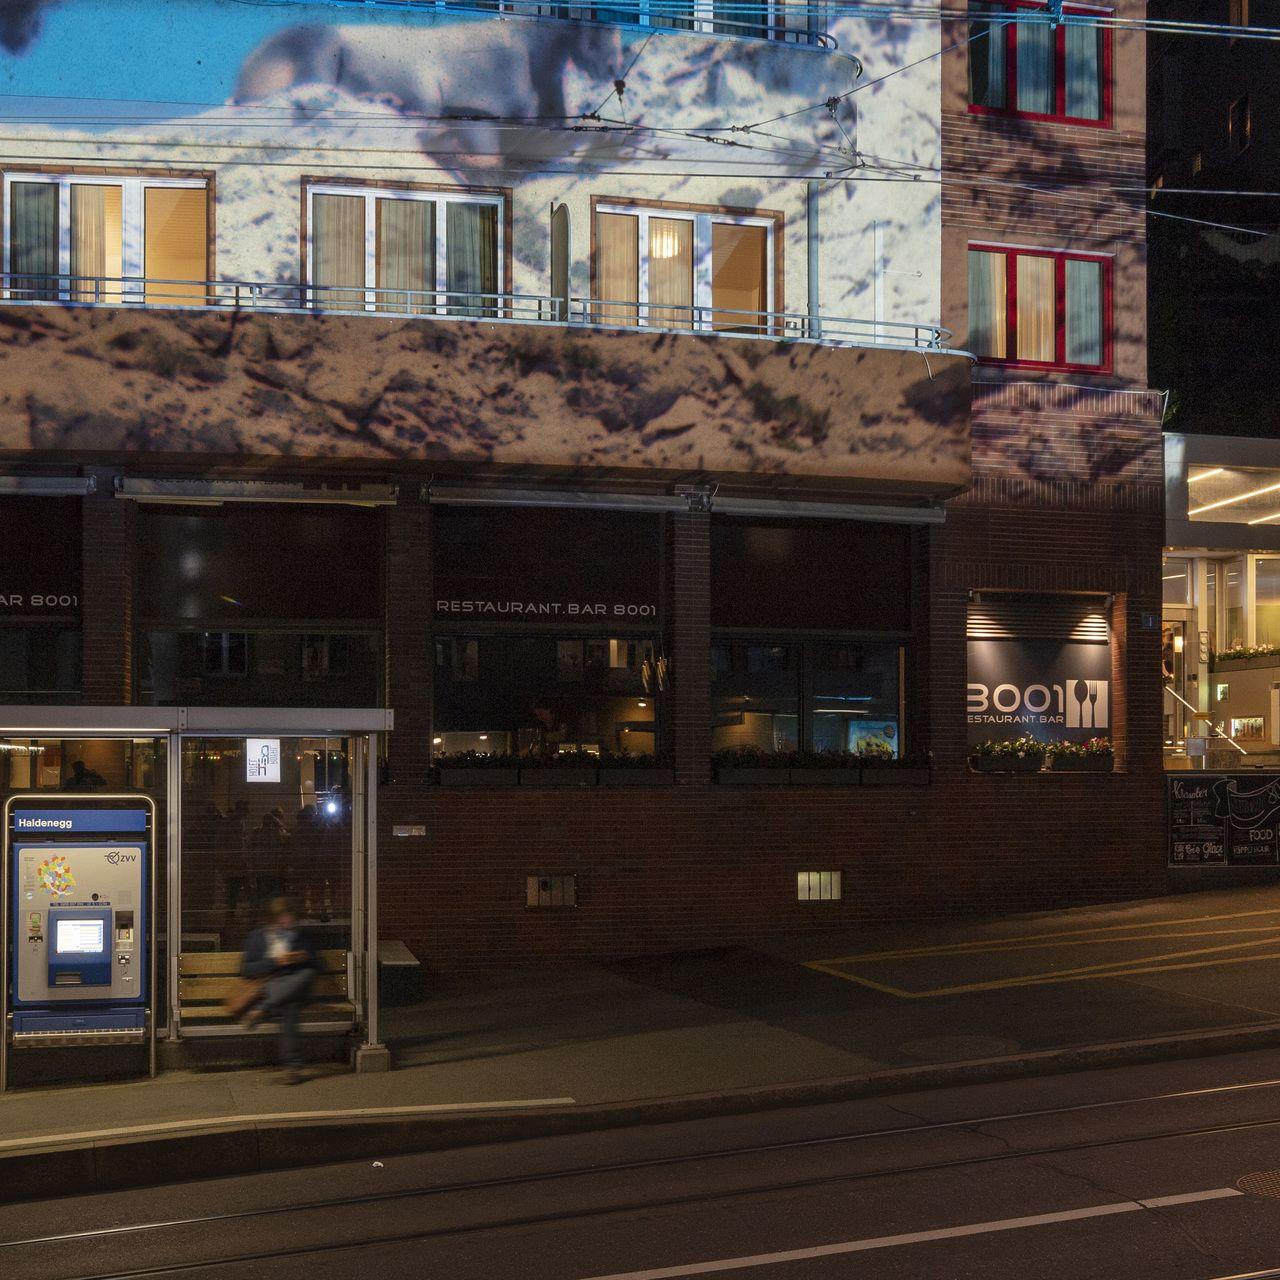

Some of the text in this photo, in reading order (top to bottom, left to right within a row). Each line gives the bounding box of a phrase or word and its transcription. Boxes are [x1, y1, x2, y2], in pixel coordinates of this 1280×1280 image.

[30, 595, 79, 607] 8001
[437, 600, 657, 616] RESTAURANT.BAR 8001
[967, 714, 1064, 724] ESTAURANT.BAR
[18, 818, 73, 828] Haldenegg
[1249, 829, 1274, 841] FOOD
